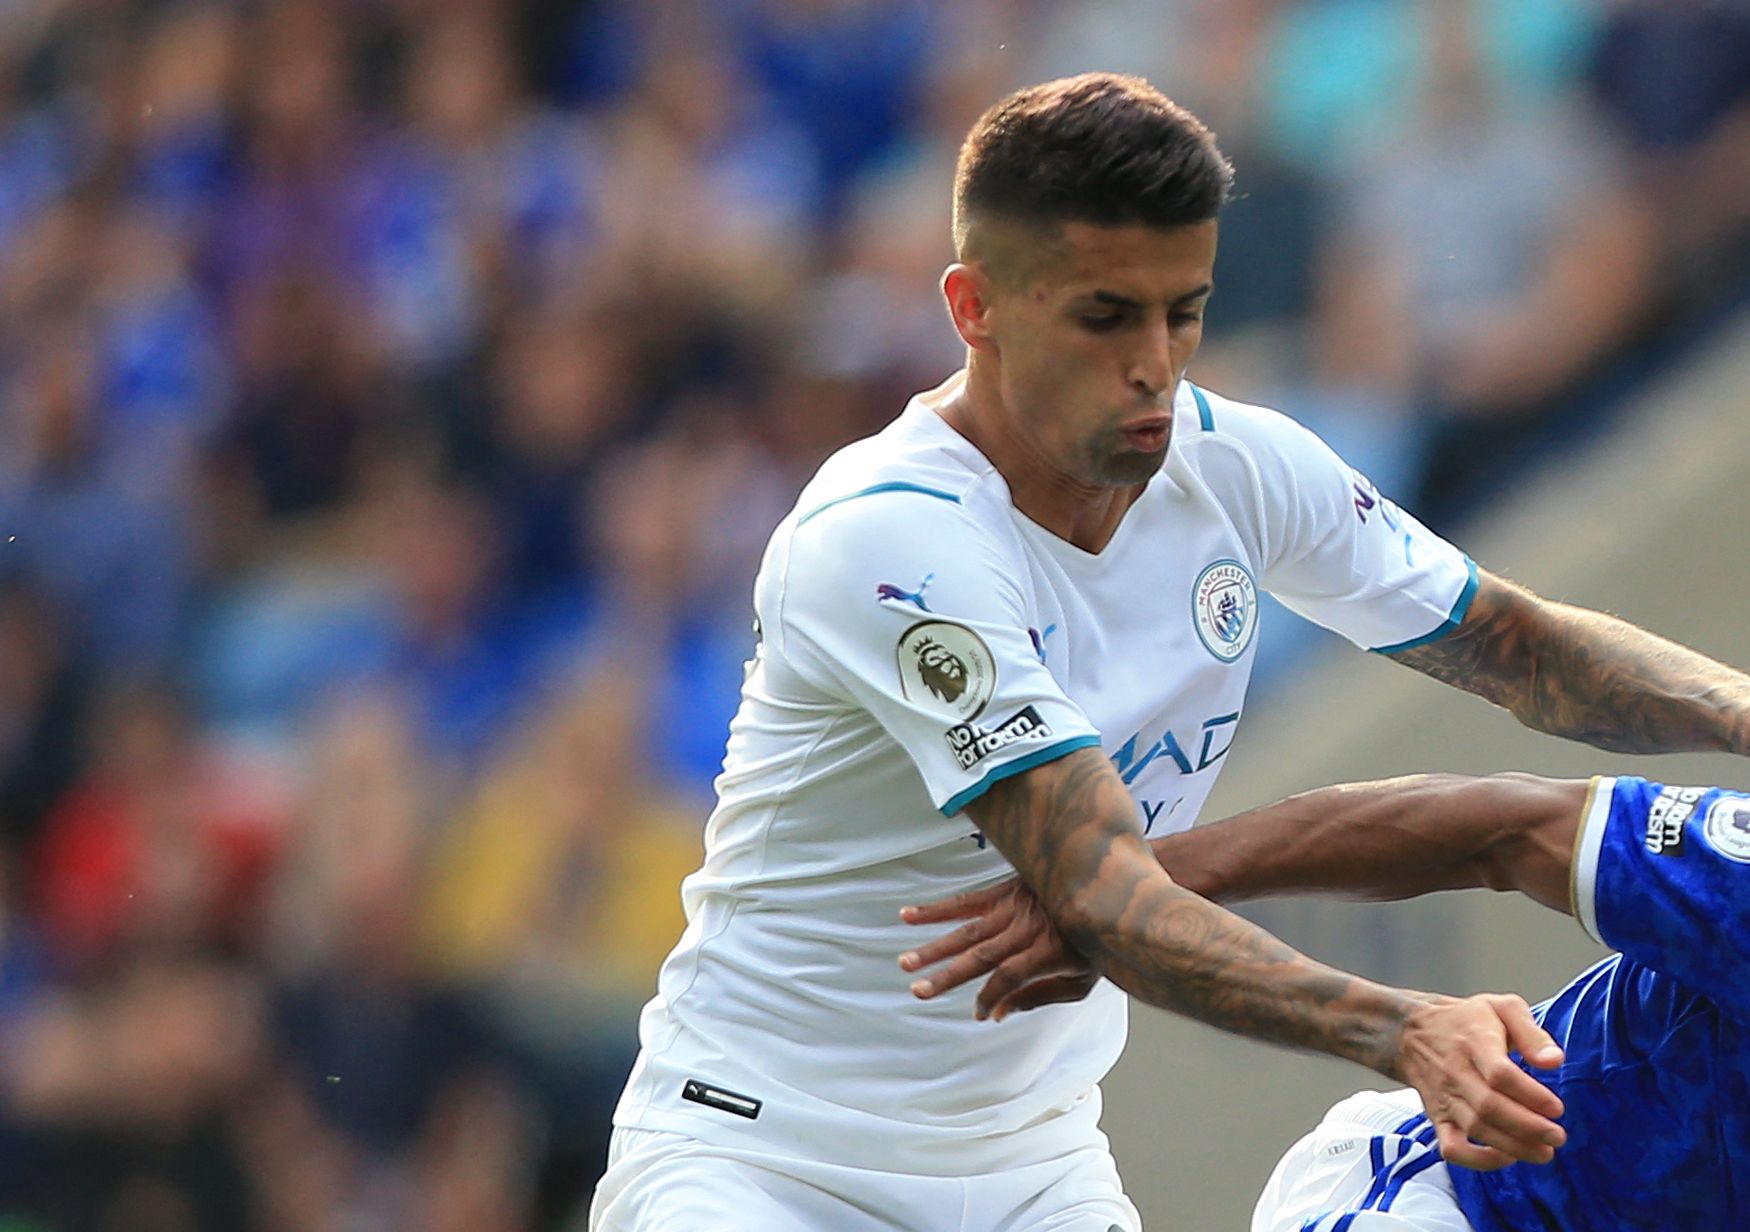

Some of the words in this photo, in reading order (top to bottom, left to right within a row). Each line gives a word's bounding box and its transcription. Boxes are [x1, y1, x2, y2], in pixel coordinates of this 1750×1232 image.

[1199, 567, 1251, 606] MANCHESTER
[1226, 642, 1242, 655] CITY
[945, 726, 971, 750] No
